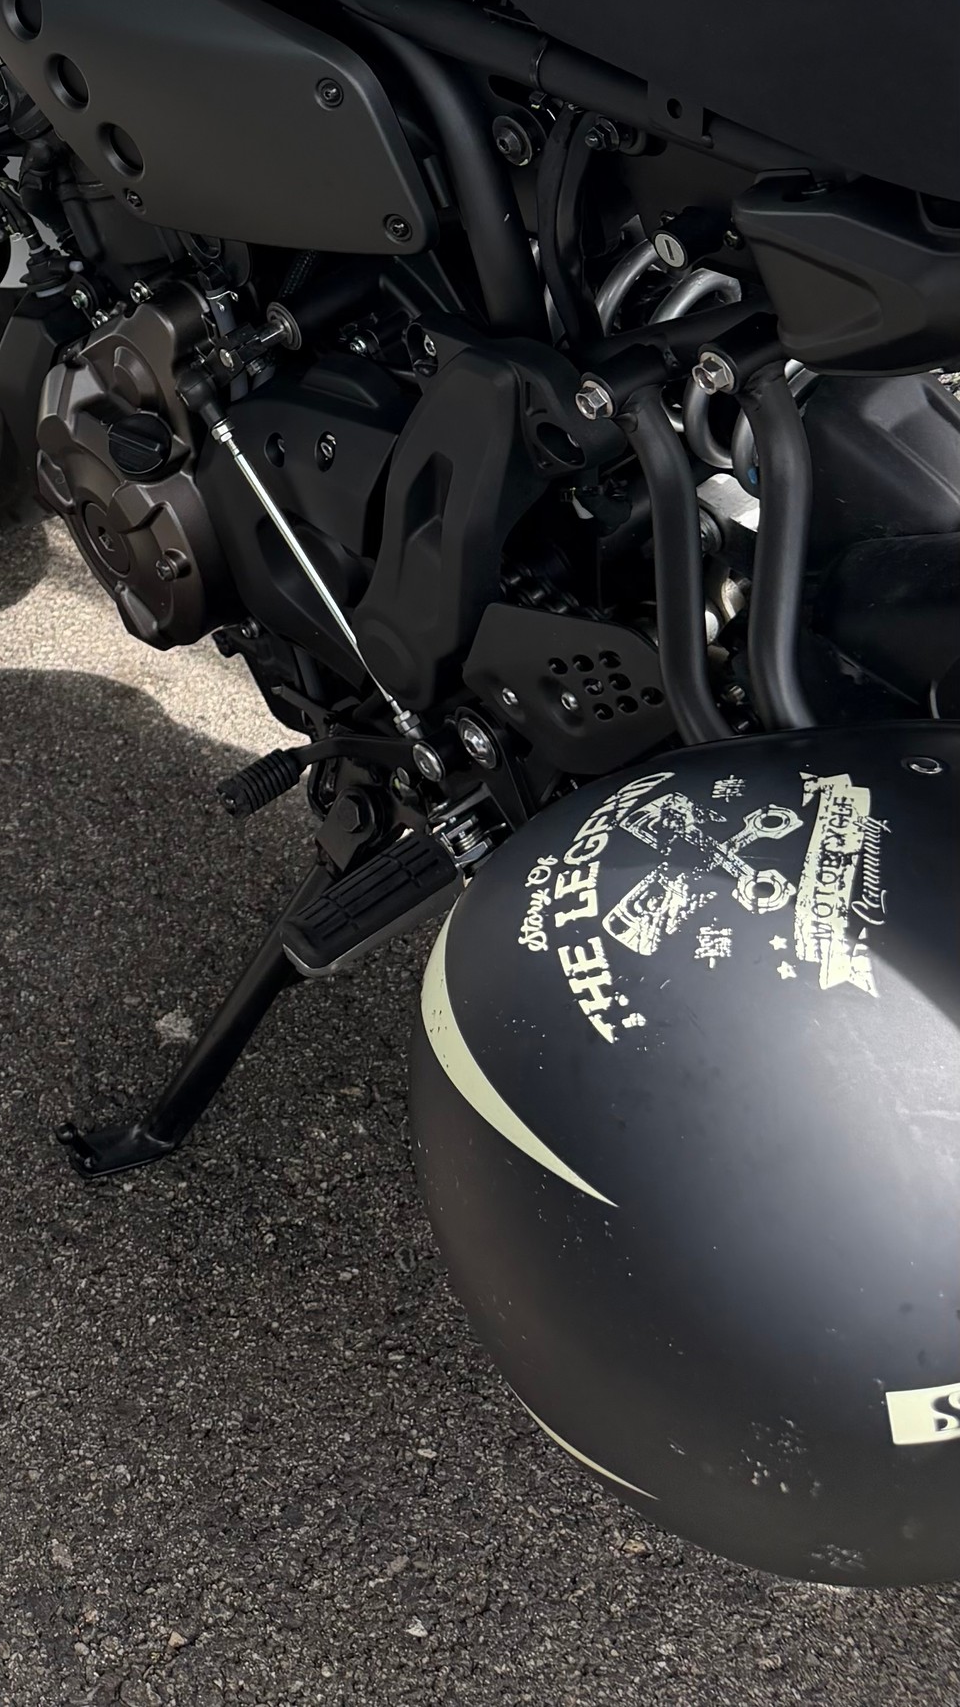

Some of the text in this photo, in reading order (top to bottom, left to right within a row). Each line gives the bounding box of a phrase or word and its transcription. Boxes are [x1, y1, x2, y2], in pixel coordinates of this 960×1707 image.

[518, 854, 558, 952] Story Of
[851, 816, 892, 926] Community
